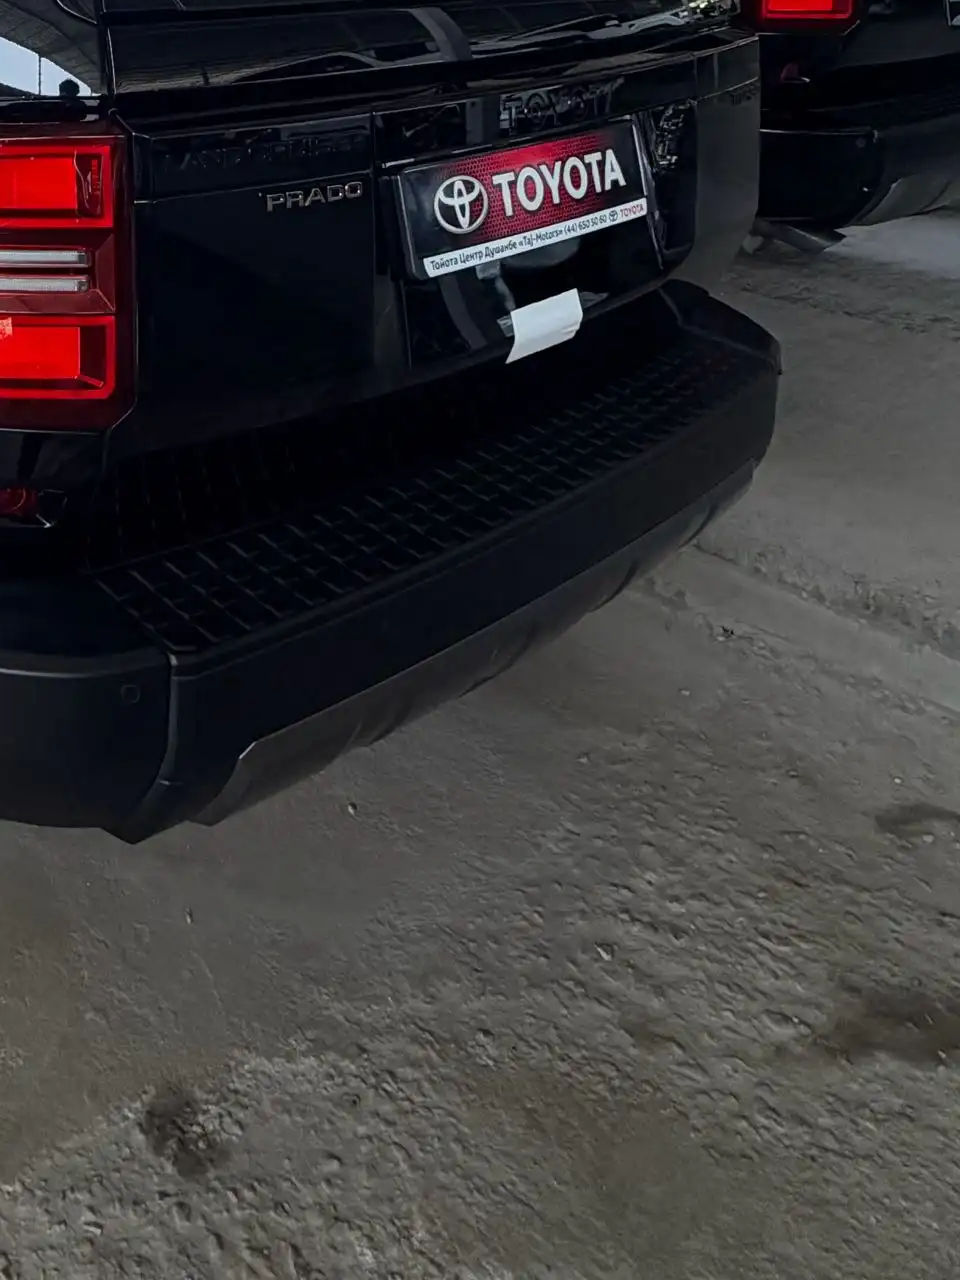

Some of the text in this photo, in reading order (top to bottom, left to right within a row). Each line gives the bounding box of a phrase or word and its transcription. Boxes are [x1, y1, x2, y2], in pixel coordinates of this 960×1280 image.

[266, 181, 363, 212] PRADO
[493, 149, 626, 217] TOYOTA
[430, 257, 459, 271] Тойота
[460, 251, 484, 265] Центр
[485, 241, 517, 258] Душанбе
[564, 223, 578, 236] (44)
[620, 204, 645, 219] TOYOTA
